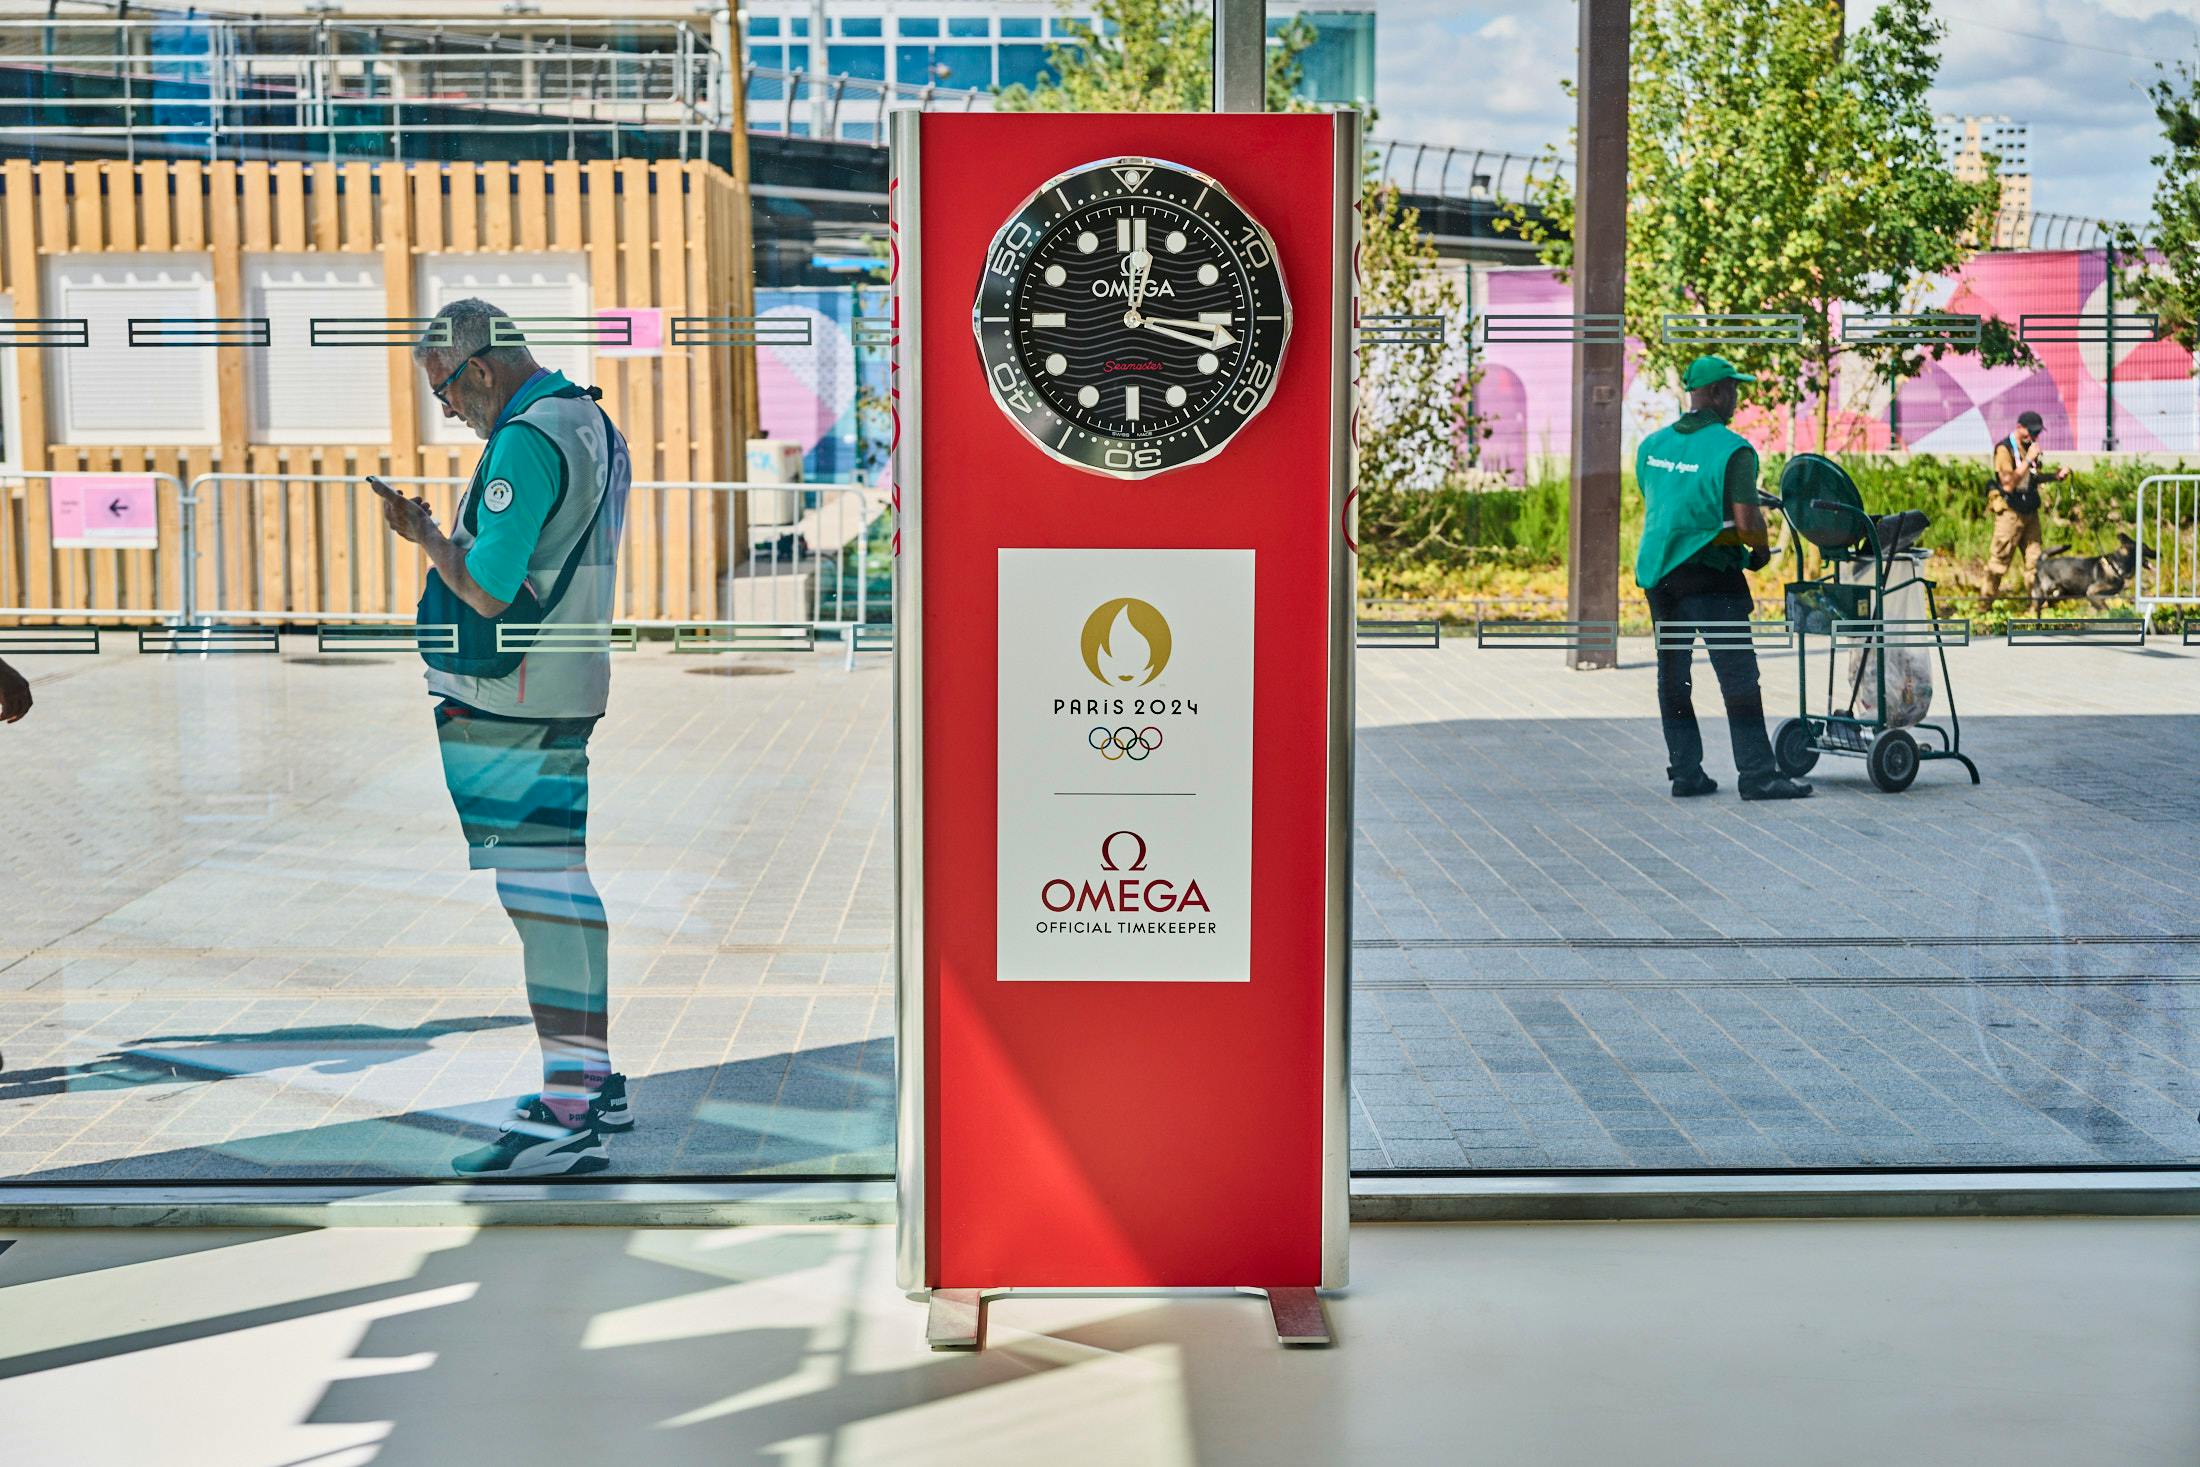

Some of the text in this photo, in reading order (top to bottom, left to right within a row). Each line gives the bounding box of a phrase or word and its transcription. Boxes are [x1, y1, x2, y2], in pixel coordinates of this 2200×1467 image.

[991, 222, 1031, 276] 50
[1240, 226, 1270, 268] 10
[1103, 360, 1164, 373] Seamaster
[993, 363, 1032, 414] 40
[1233, 360, 1272, 415] 20
[1105, 448, 1162, 468] 30
[1134, 699, 1199, 715] 2024
[1041, 878, 1211, 912] OMEGA
[1036, 921, 1217, 934] OFFICIAL TIMEKEEPER
